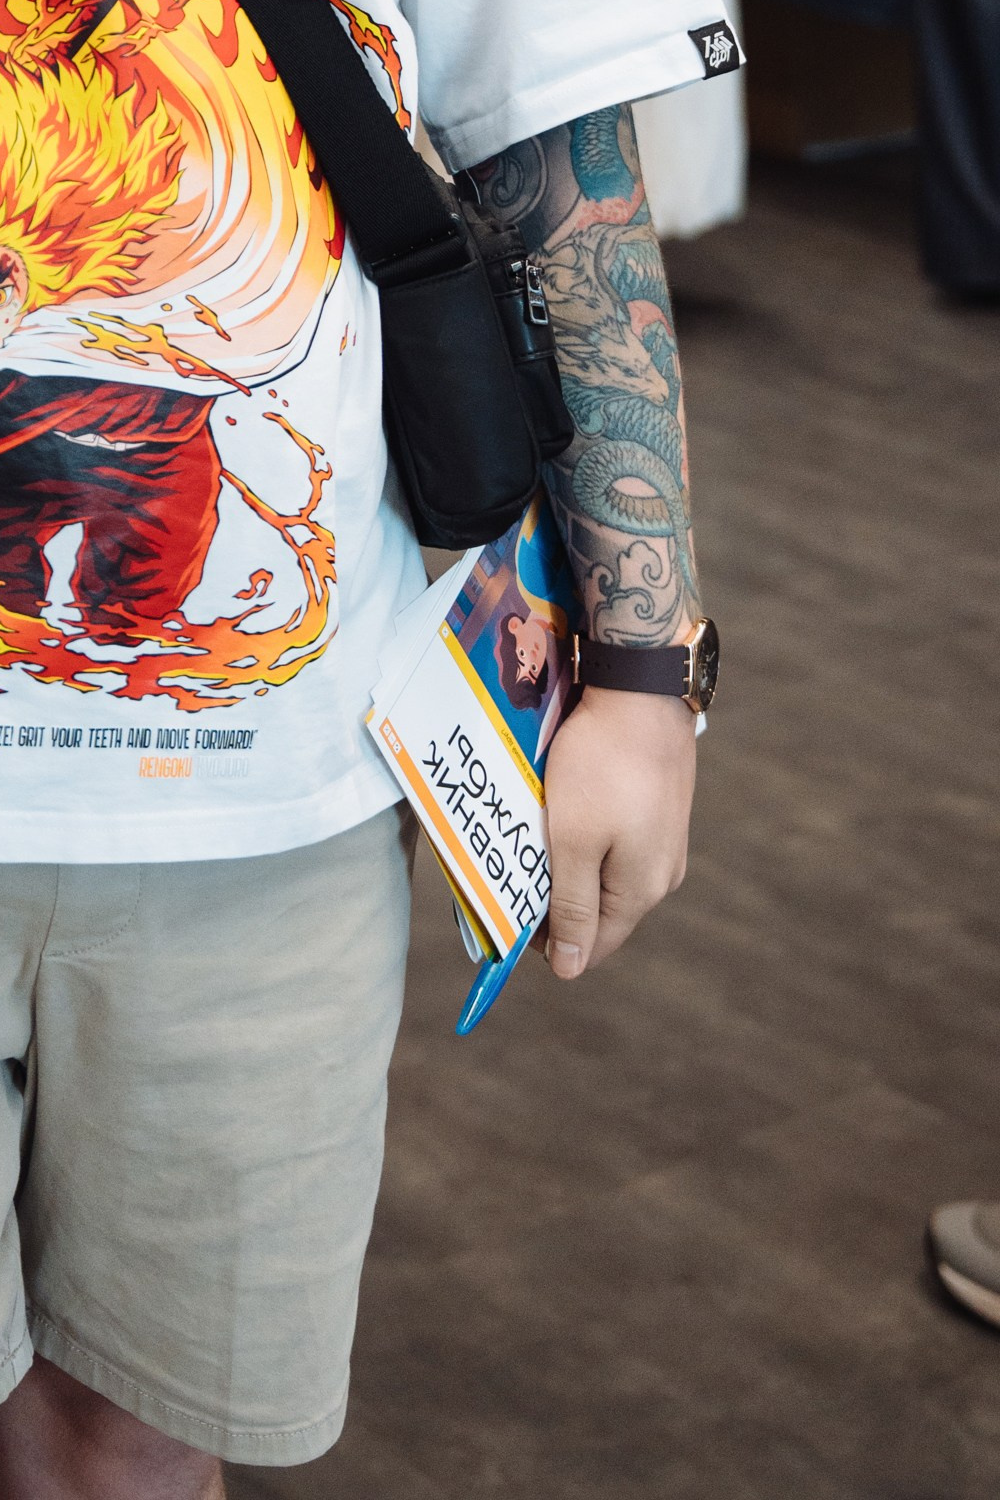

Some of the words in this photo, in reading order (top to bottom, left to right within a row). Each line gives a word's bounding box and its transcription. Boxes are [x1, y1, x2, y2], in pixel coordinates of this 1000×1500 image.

[18, 726, 46, 748] GRIT
[51, 727, 83, 748] YOUR
[88, 727, 123, 749] TEETH
[127, 728, 152, 749] AND
[156, 728, 190, 750] MOVE
[139, 756, 193, 778] RENGOKU
[422, 740, 541, 931] дневник
[448, 723, 552, 902] дружбы
